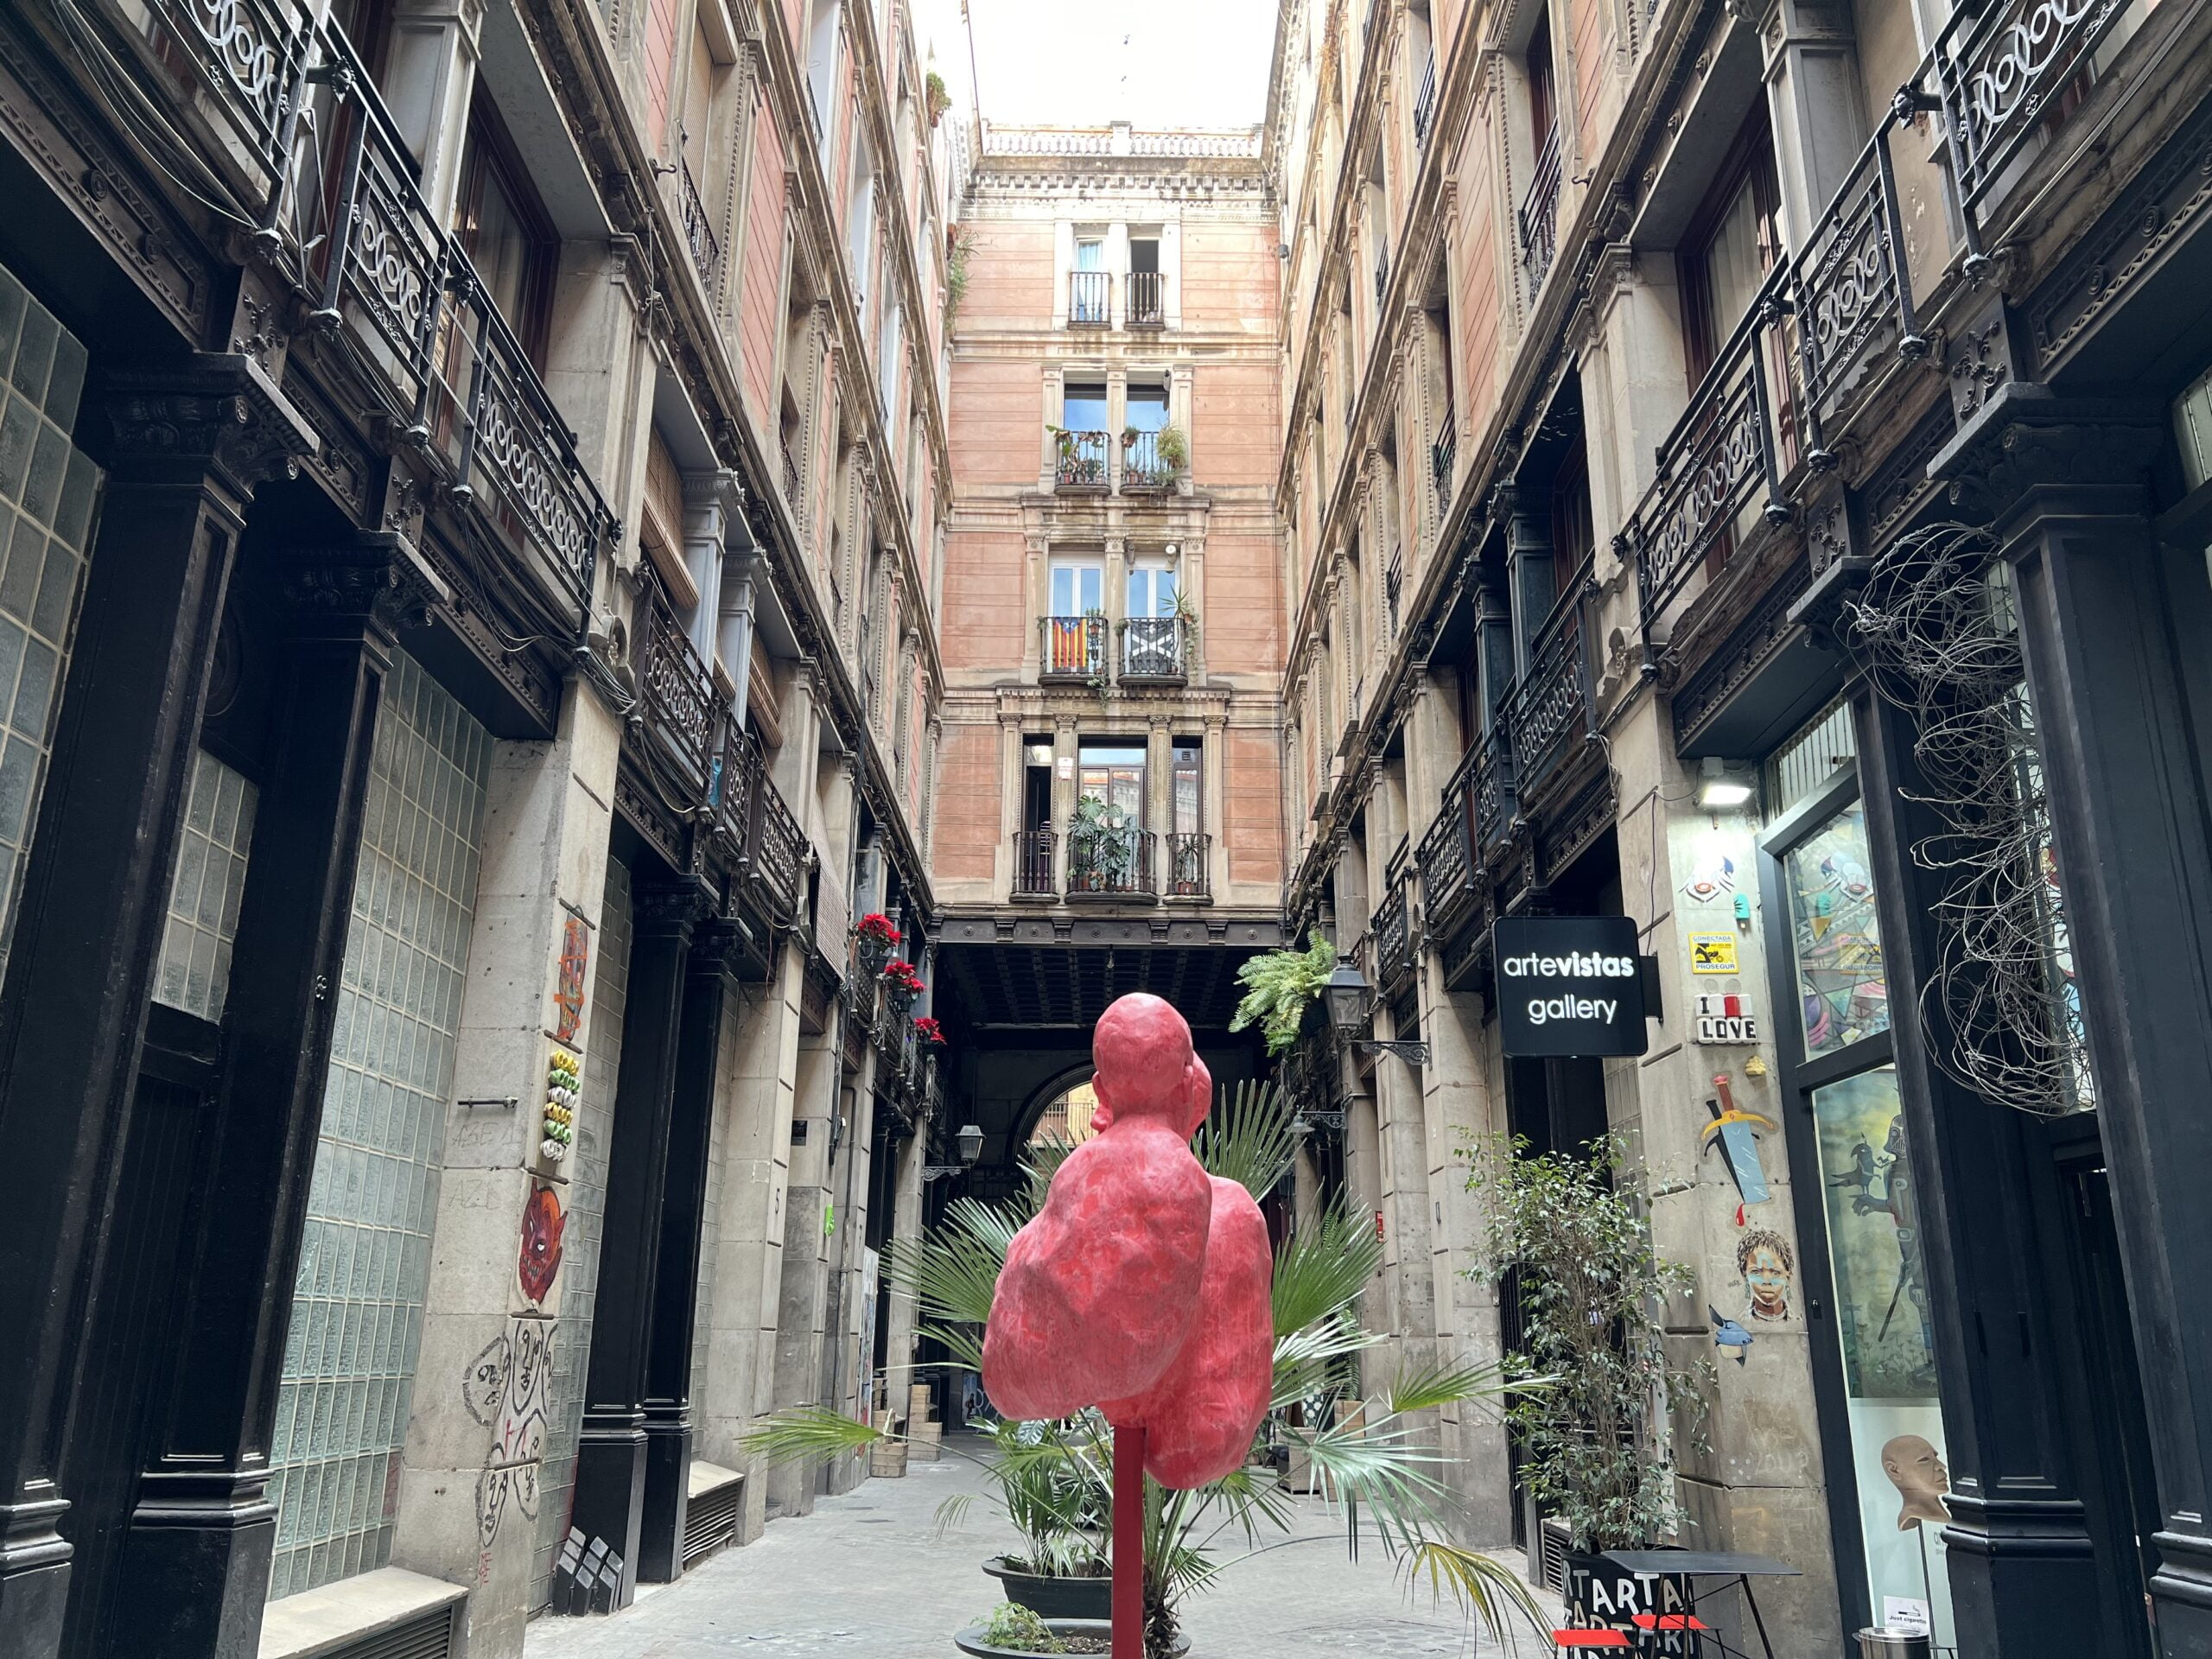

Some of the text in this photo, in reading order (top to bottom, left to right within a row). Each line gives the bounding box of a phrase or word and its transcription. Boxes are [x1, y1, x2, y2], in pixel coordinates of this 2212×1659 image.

[1503, 950, 1635, 977] artevistas
[1528, 994, 1618, 1025] gallery
[1700, 996, 1710, 1014] I
[1702, 1020, 1756, 1039] LOVE
[1563, 1560, 1591, 1599] RT
[1592, 1573, 1660, 1615] ART
